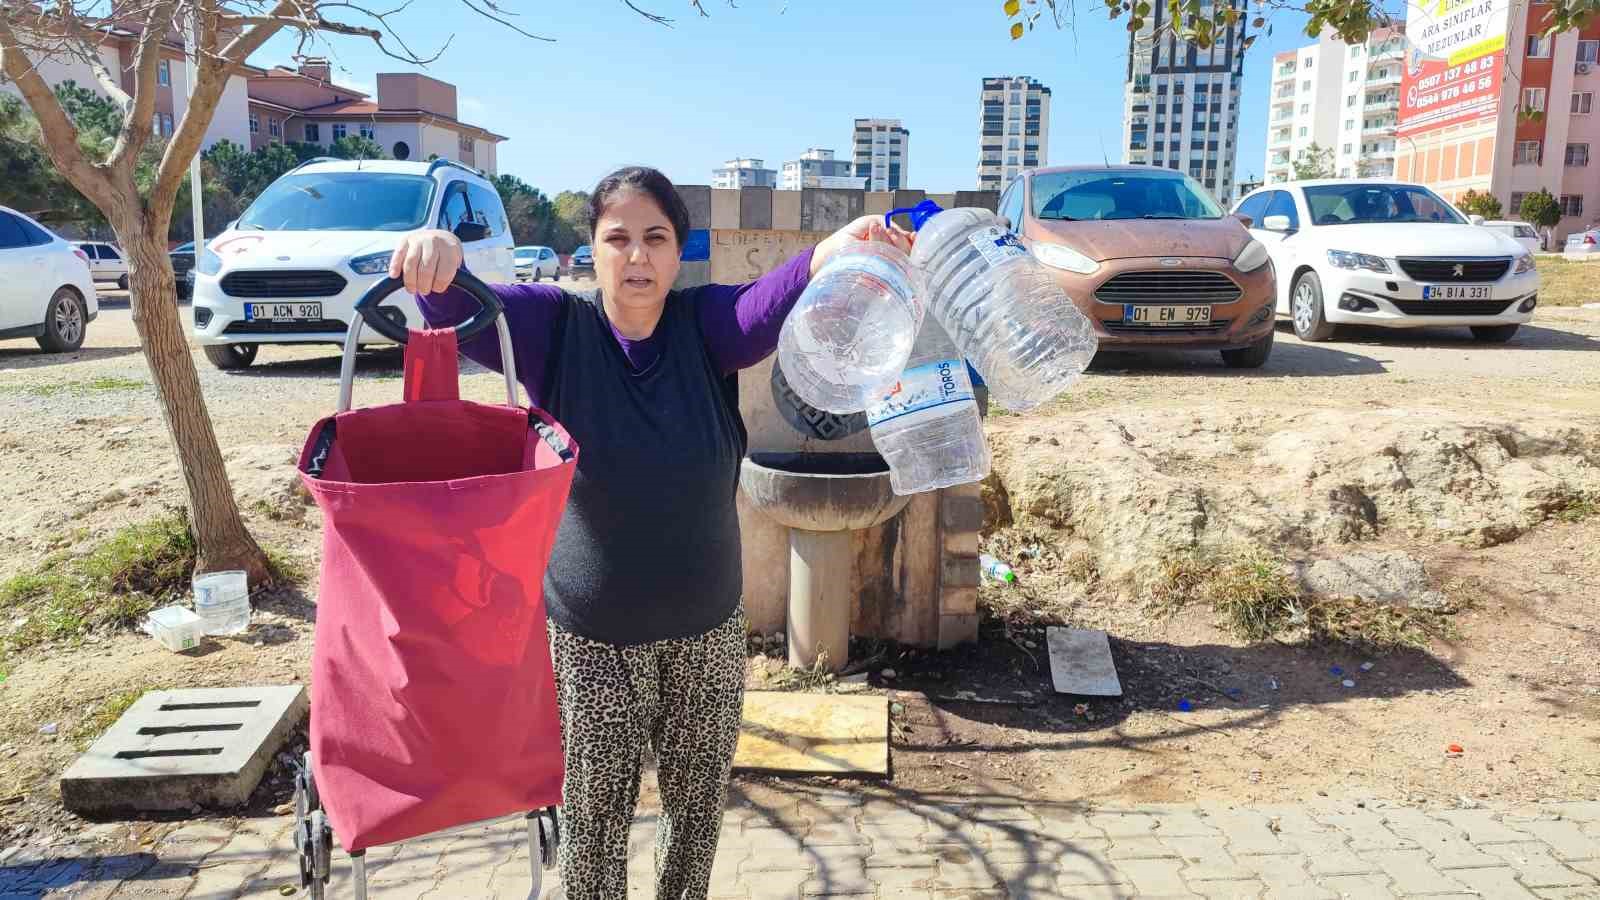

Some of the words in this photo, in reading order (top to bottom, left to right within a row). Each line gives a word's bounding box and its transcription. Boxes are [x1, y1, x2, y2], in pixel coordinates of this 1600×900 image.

[1422, 23, 1440, 39] ARA
[1442, 1, 1492, 30] SINIFLAR
[1427, 24, 1482, 55] MEZUNLAR
[1418, 74, 1440, 90] 0507
[1444, 67, 1461, 81] 137
[1430, 287, 1442, 298] 34
[1447, 287, 1465, 298] BIA
[1470, 287, 1488, 298] 331
[252, 304, 265, 318] 01
[272, 304, 294, 318] ACN
[299, 304, 320, 317] 920
[1134, 307, 1149, 321] 01
[1159, 307, 1176, 321] EN
[1186, 307, 1210, 321] 979
[938, 362, 956, 397] TOROS
